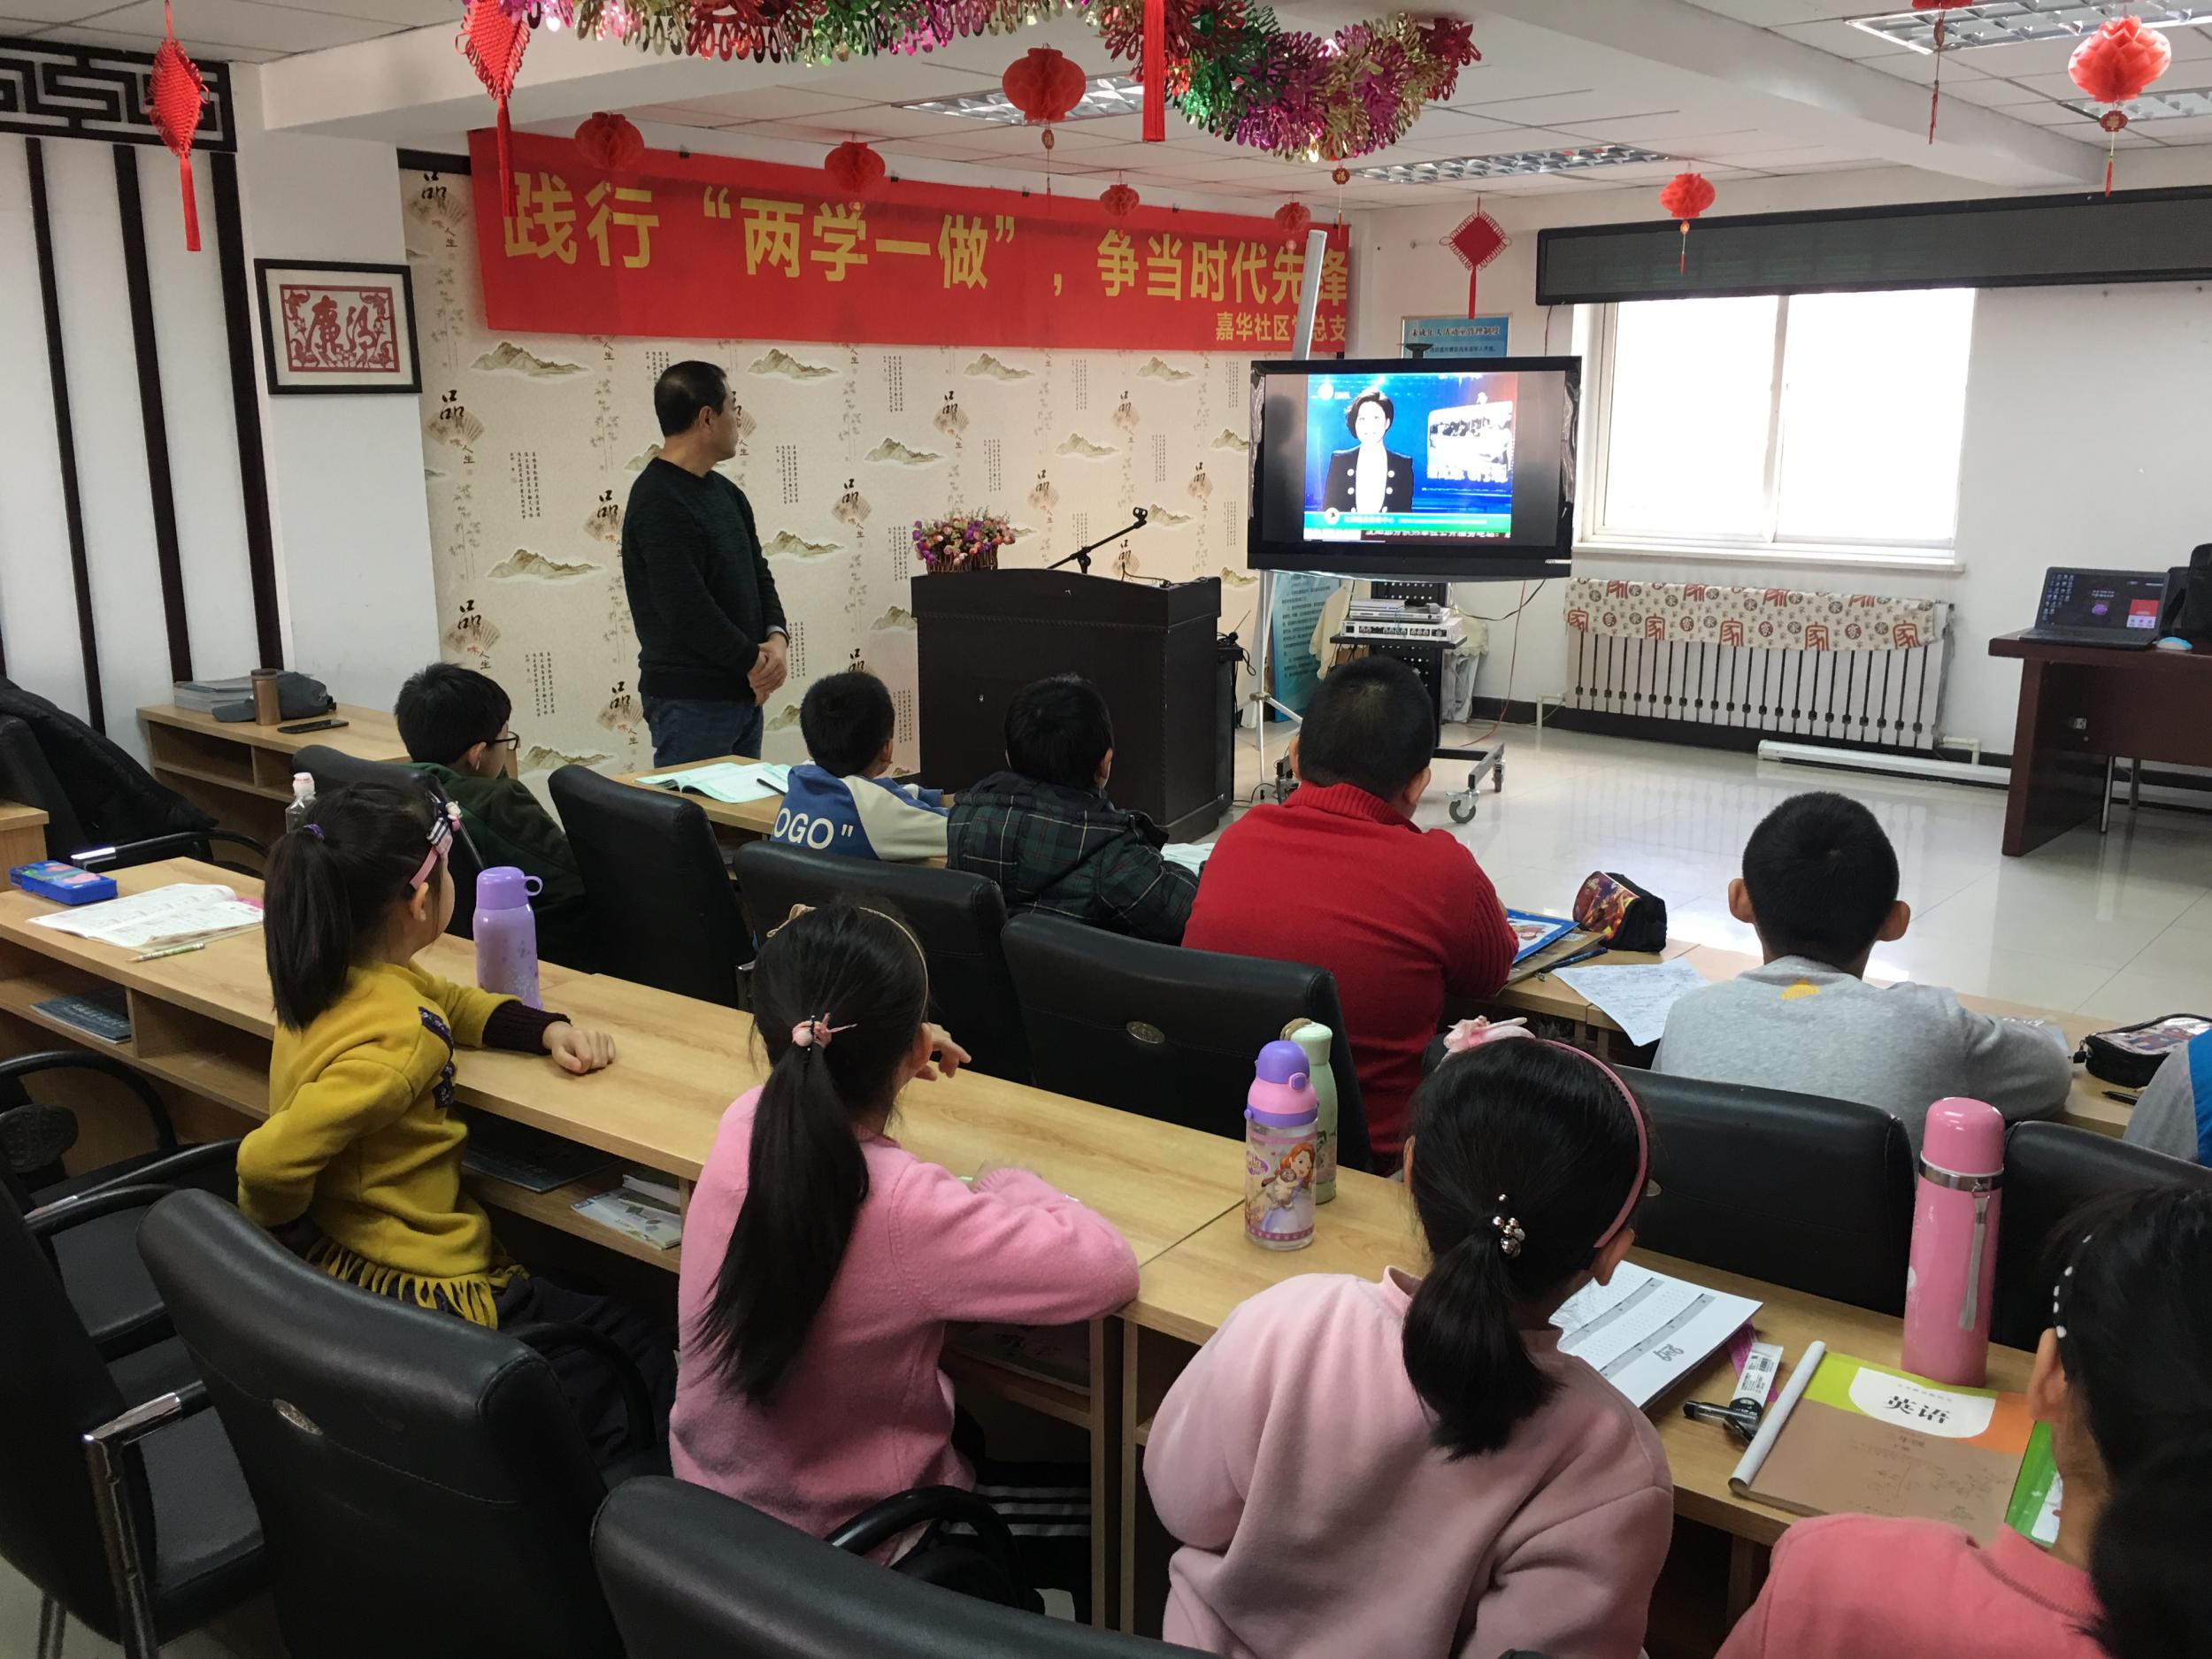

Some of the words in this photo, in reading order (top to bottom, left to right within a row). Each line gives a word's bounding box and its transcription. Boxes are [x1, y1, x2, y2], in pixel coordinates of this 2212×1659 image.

[1216, 311, 1346, 342] 嘉华社区总支
[1884, 1395, 1952, 1425] 英语
